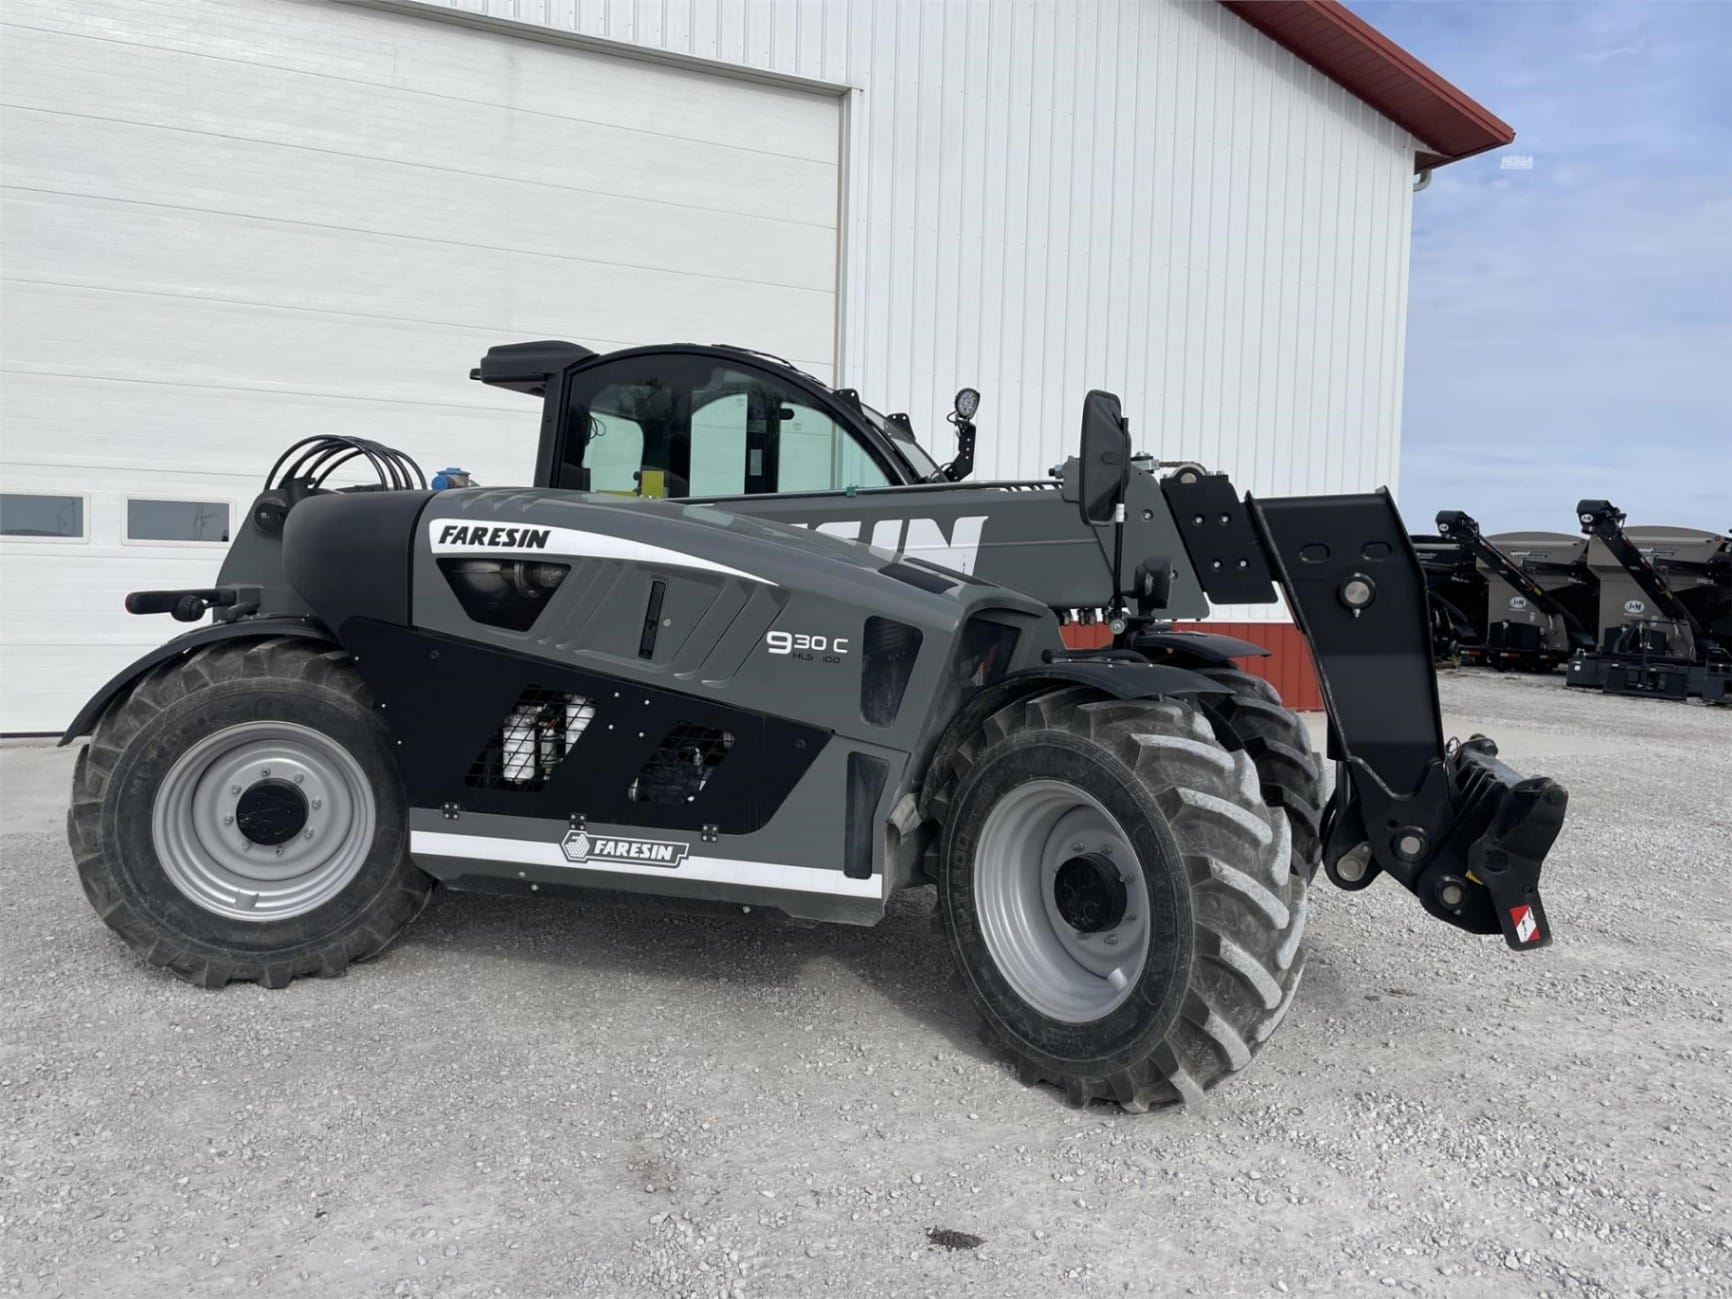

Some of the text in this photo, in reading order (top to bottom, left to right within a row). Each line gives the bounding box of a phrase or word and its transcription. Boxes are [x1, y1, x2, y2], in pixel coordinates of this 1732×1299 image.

[438, 525, 552, 549] FARESIN
[766, 631, 848, 655] 930 C
[793, 652, 841, 664] HLS 100
[594, 839, 673, 861] FARESIN
